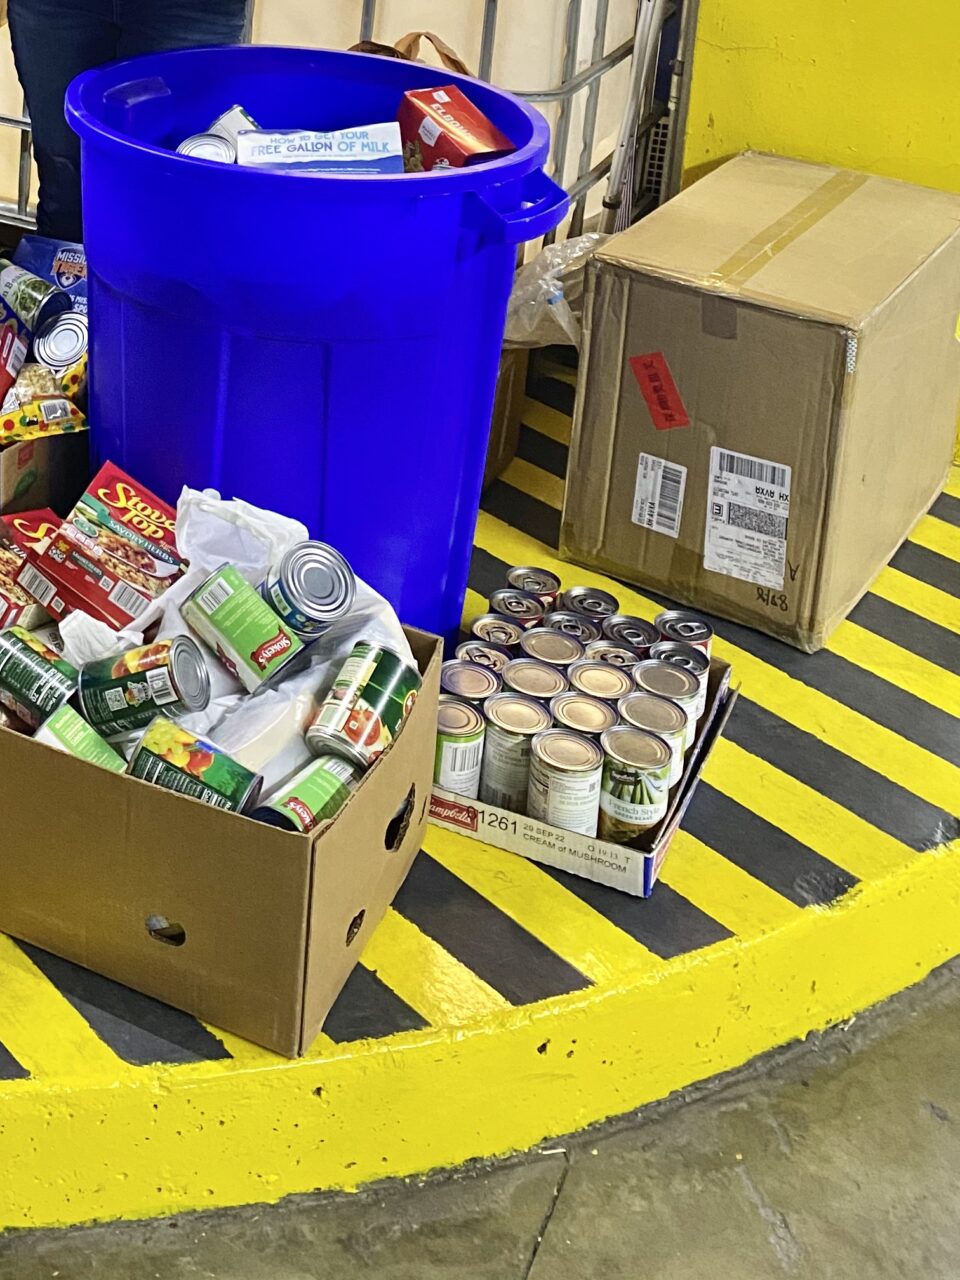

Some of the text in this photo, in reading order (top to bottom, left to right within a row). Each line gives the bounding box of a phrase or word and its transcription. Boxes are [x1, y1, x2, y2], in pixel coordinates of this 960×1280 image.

[251, 144, 282, 157] FREE
[286, 141, 333, 153] GALLON
[337, 141, 358, 153] OF
[361, 141, 391, 153] MILK
[270, 130, 369, 145] HOW TO GET YOUR
[56, 250, 87, 264] MISSI
[97, 482, 176, 532] Stove
[120, 508, 165, 539] Top
[109, 520, 145, 545] SAVORY
[143, 538, 175, 565] HERBS
[787, 559, 801, 582] A
[258, 636, 291, 664] Stokely's
[287, 801, 314, 829] okely's
[430, 802, 472, 824] ampbell's
[536, 827, 554, 838] SEP
[555, 834, 566, 843] 22
[523, 833, 627, 874] CREAM of MUSHROOM
